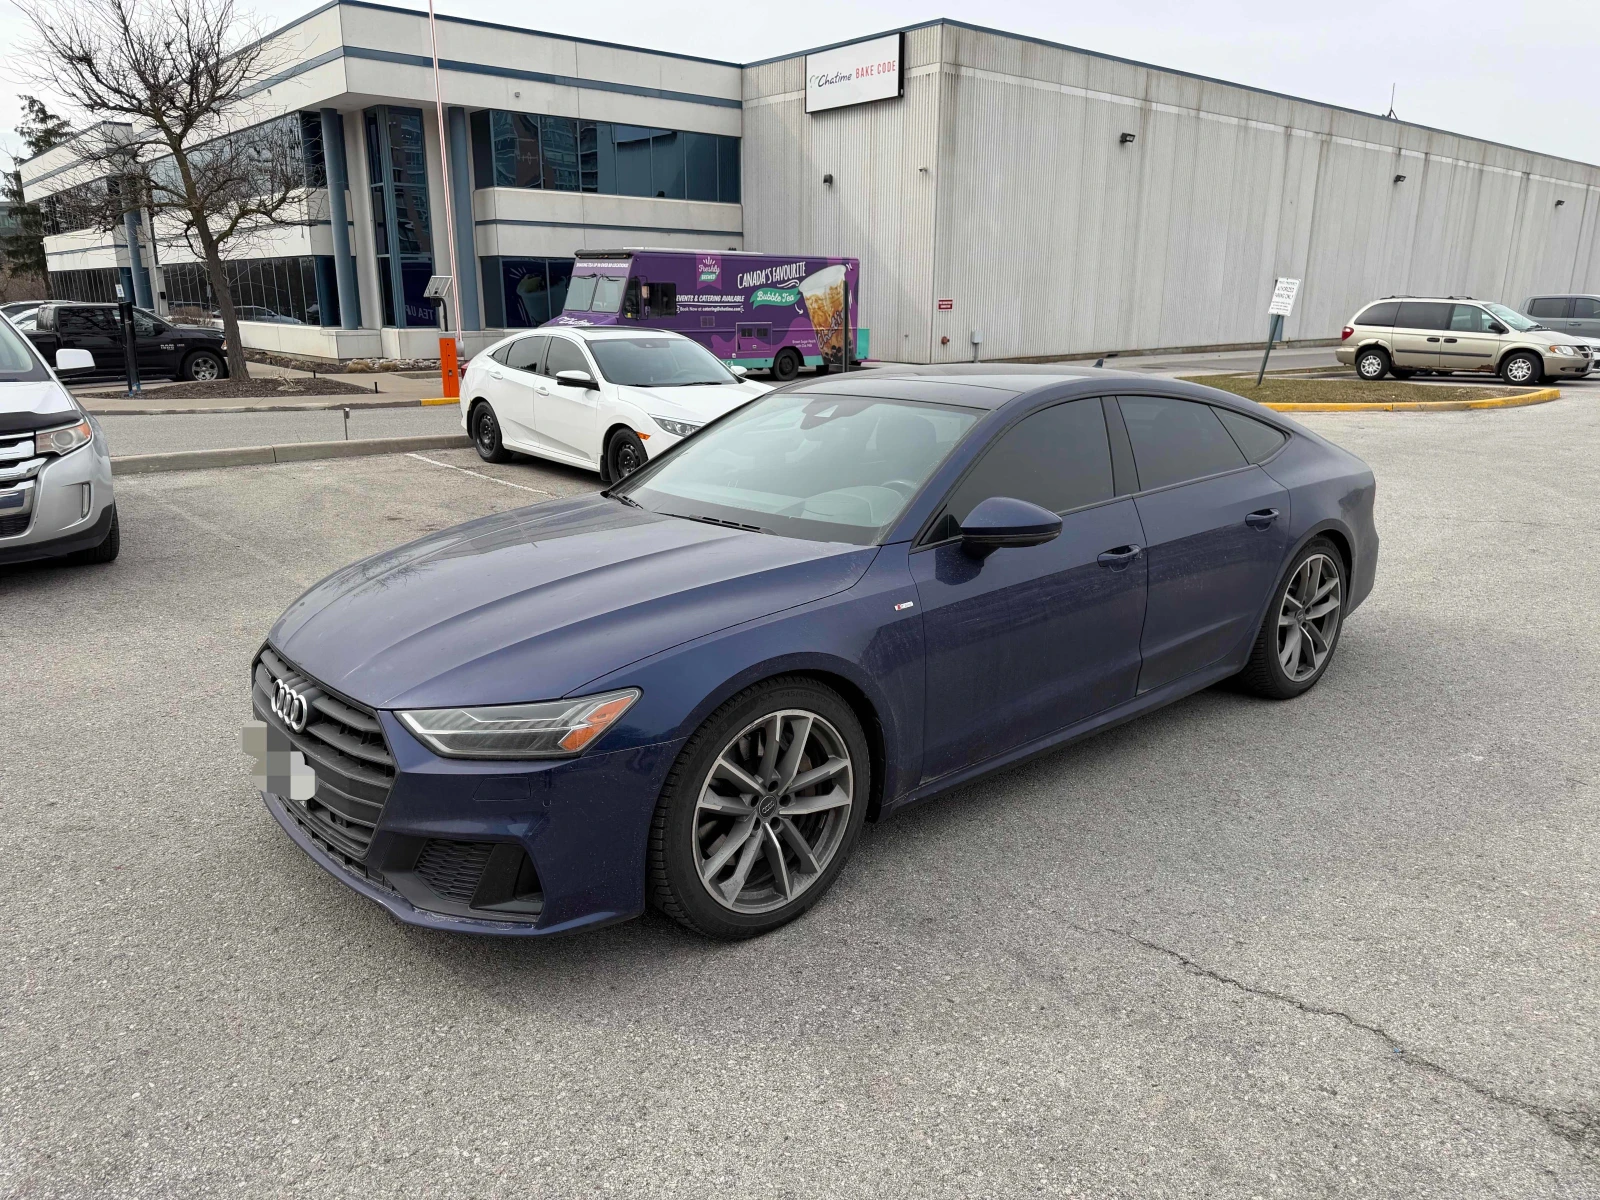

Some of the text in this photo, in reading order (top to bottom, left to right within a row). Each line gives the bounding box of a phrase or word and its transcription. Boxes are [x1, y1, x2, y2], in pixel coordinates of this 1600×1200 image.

[817, 60, 896, 88] Chatime BAKE CODE
[737, 261, 806, 289] CANADA'S FAVOURITE
[721, 295, 745, 303] AVAILABLE
[756, 291, 795, 303] Bubble Tea
